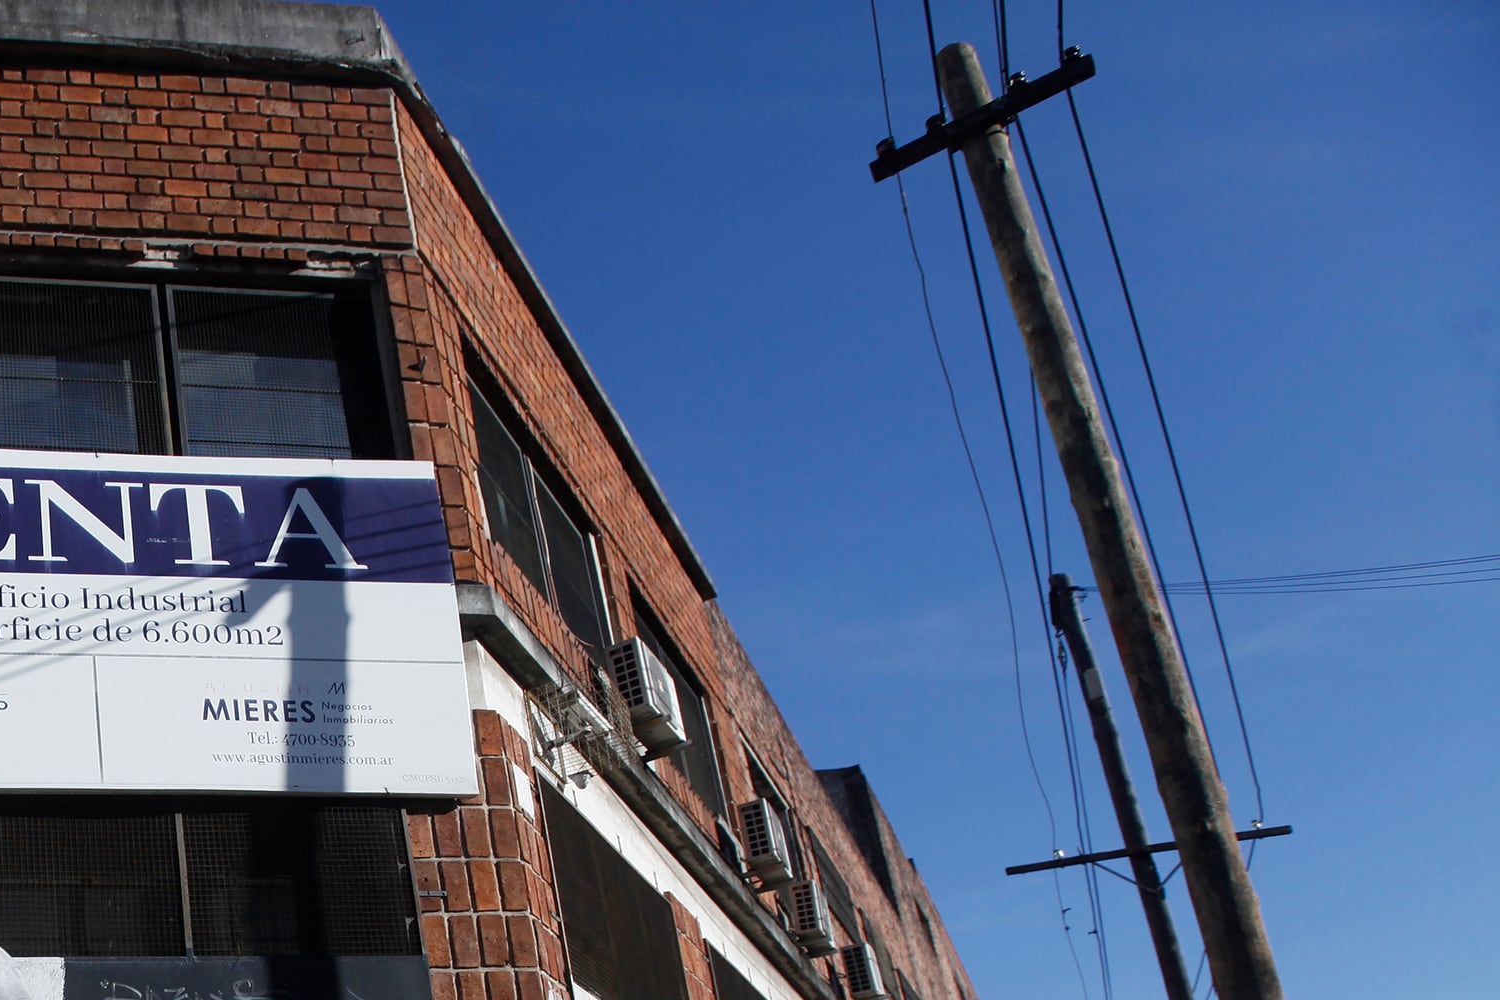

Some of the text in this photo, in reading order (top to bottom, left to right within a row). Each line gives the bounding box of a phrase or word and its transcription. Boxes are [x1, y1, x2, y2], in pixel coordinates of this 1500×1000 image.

[80, 586, 249, 614] Industrial
[91, 617, 133, 643] de
[142, 619, 285, 647] 6.600m2
[202, 698, 316, 724] MIERES
[321, 702, 373, 714] Negocios
[322, 715, 395, 727] Inmobiliarios
[246, 731, 357, 748] Tel.: 4700-8935
[212, 751, 395, 767] www.agustinmieres.com.ar
